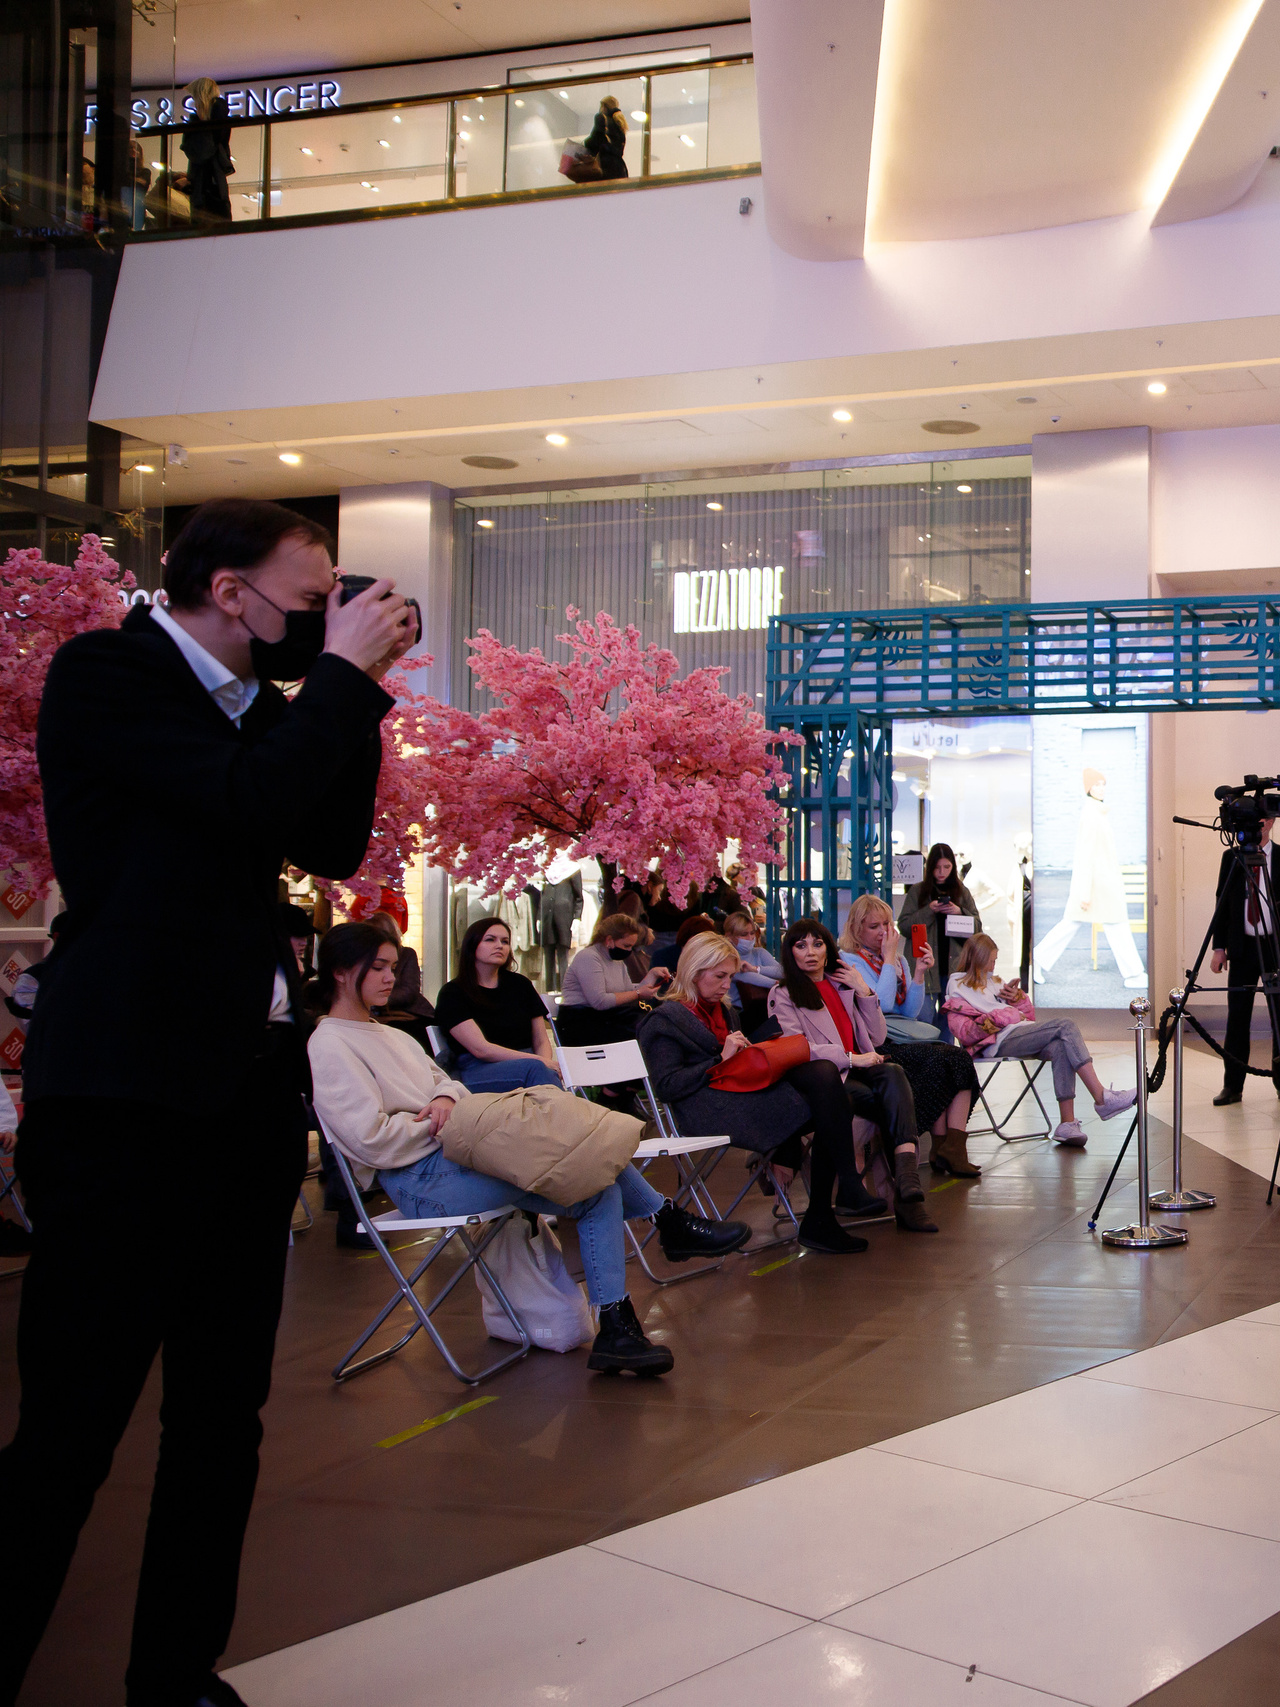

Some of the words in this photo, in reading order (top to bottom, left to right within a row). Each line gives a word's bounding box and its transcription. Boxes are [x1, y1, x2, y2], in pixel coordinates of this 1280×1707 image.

[156, 97, 175, 125] &
[180, 80, 341, 124] SENCER
[673, 566, 785, 633] MEZZATORRE
